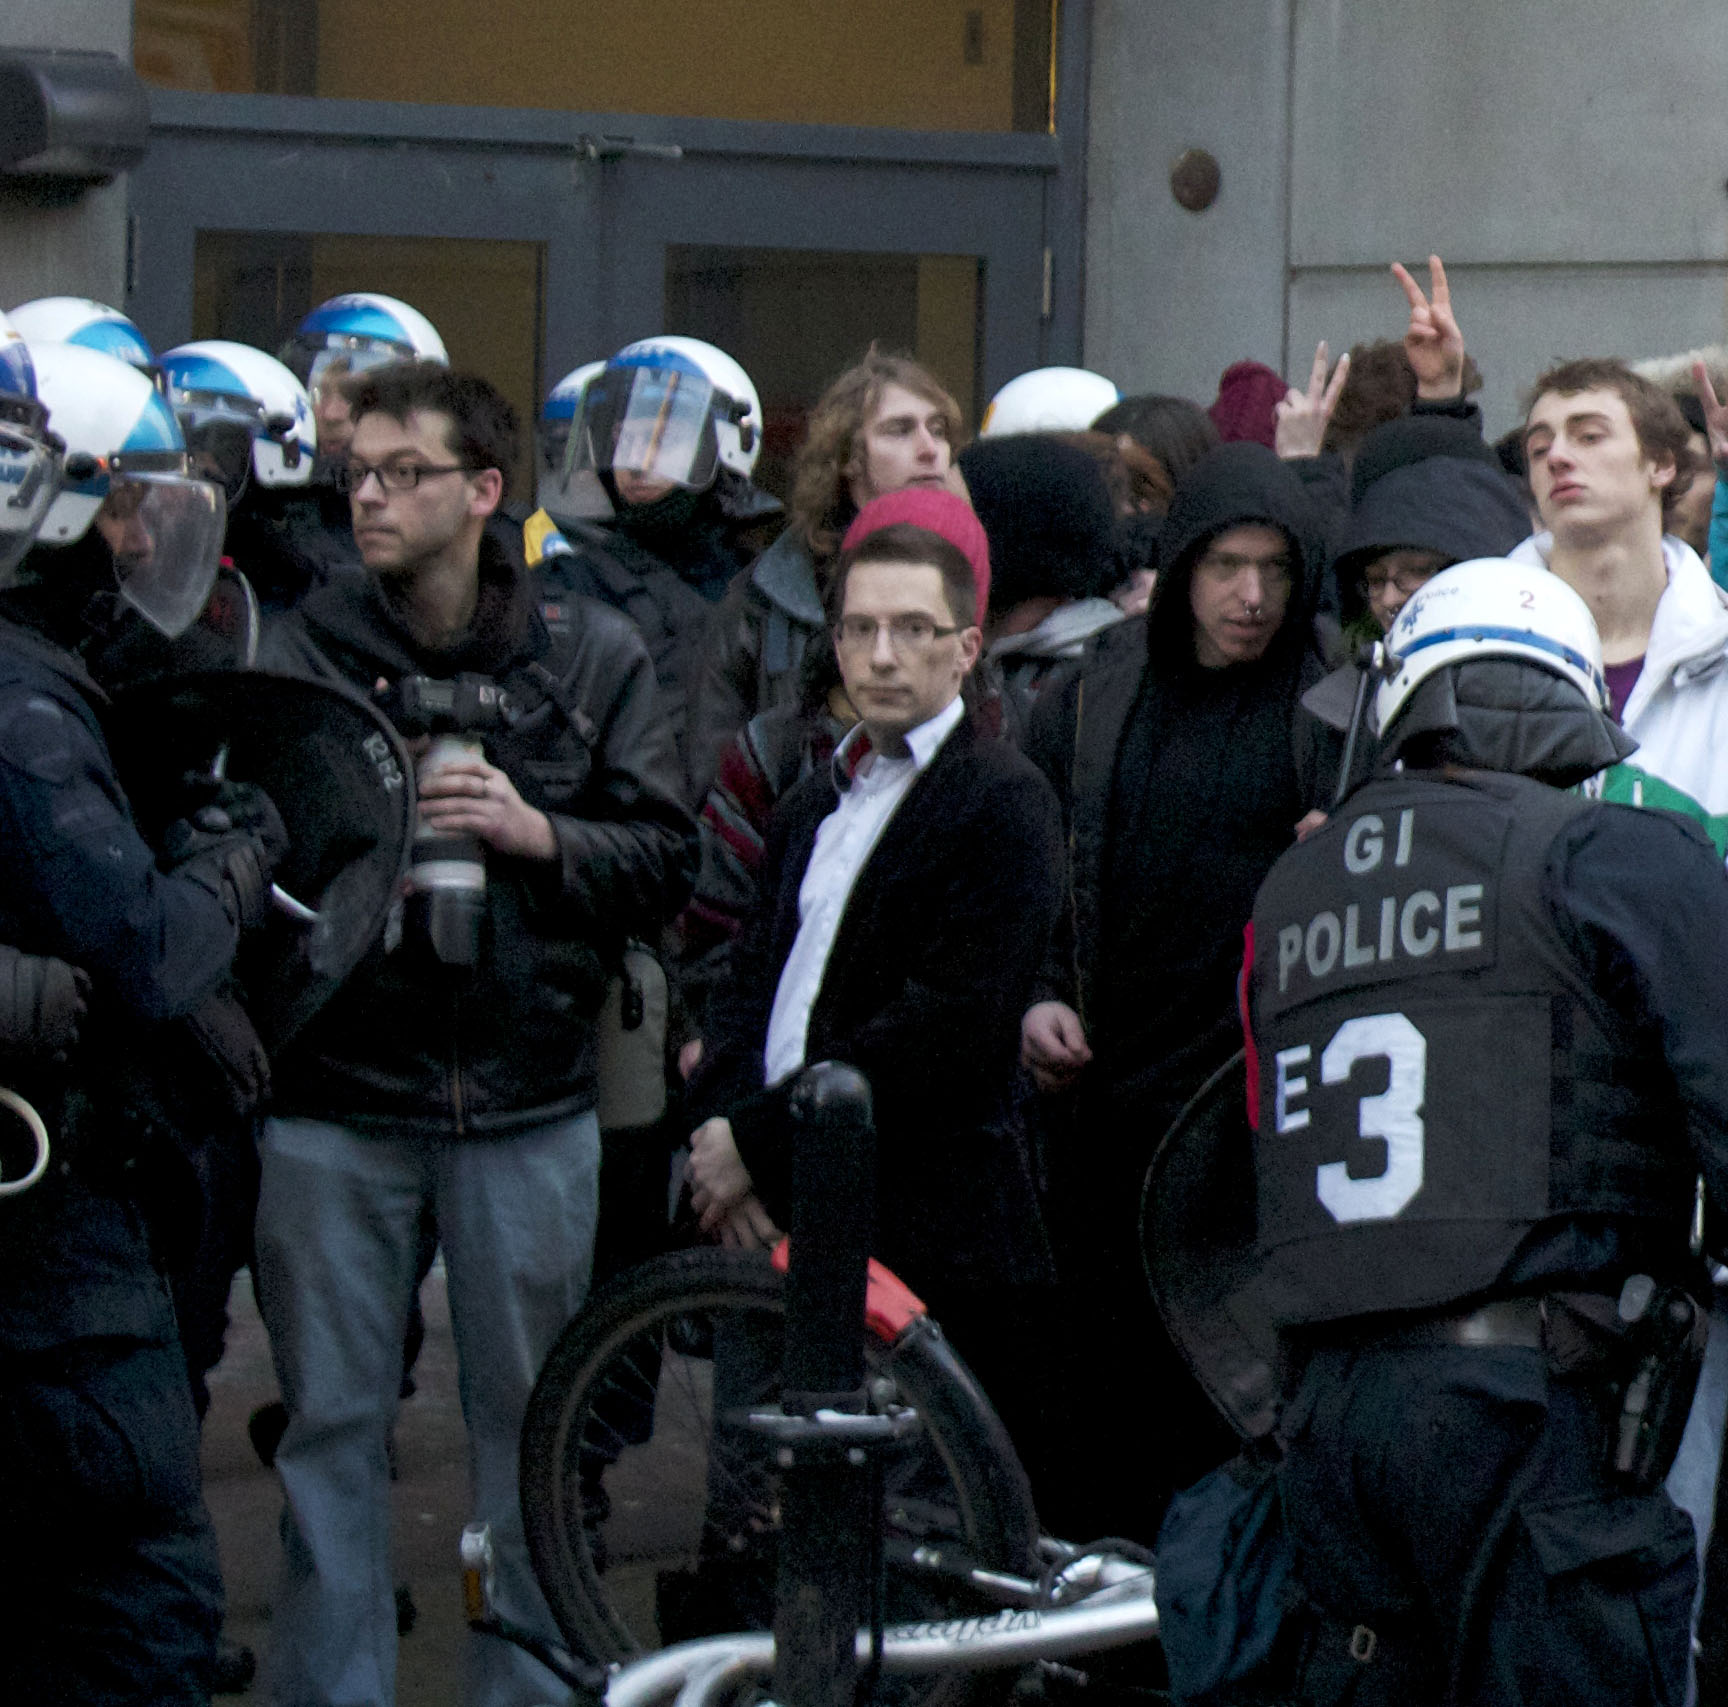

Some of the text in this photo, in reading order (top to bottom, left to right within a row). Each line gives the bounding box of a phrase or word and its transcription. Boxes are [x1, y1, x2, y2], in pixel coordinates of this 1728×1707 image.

[1519, 590, 1535, 610] 2
[1345, 809, 1414, 873] GI
[1278, 884, 1484, 992] POLICE
